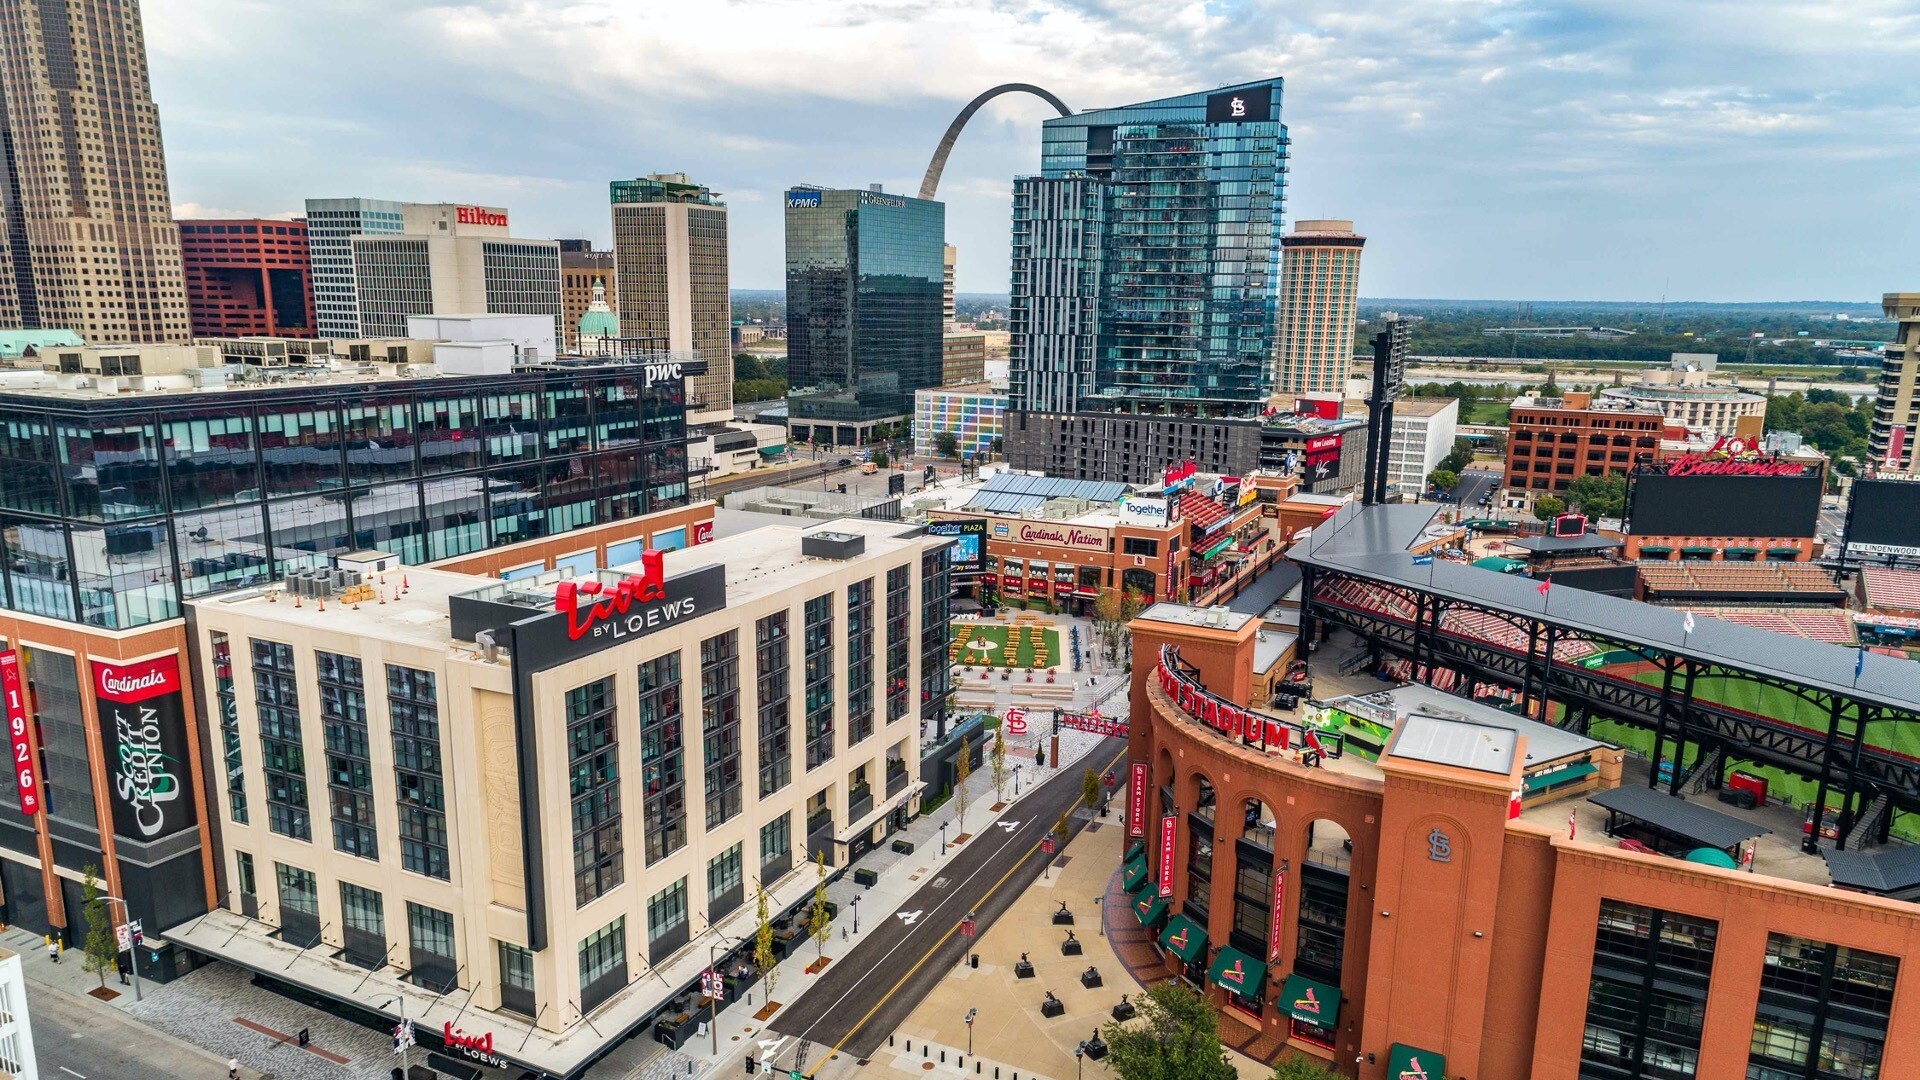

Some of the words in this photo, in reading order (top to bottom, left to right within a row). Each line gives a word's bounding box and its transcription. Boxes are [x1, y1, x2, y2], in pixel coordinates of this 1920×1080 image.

[787, 198, 818, 208] KPMG
[456, 207, 508, 227] Hilton
[644, 363, 682, 388] pwc
[1312, 440, 1321, 449] Now
[1321, 437, 1337, 447] Leasing
[1665, 453, 1805, 477] Budweiser
[1876, 471, 1920, 481] WORLD
[1126, 502, 1166, 515] Together
[929, 524, 962, 535] Together
[1020, 524, 1064, 542] Cardinals
[1064, 529, 1103, 546] Nation
[1864, 544, 1918, 555] LINDENWOOD
[555, 549, 667, 641] Live!
[593, 623, 611, 637] BY
[613, 597, 696, 639] LOEWS
[102, 668, 166, 694] Cardinals
[1180, 683, 1291, 751] STADIUM
[8, 690, 33, 788] 1926
[114, 709, 138, 802] SCOTT
[140, 706, 180, 804] UNION
[129, 723, 164, 836] CREDIT
[444, 1021, 494, 1055] Live!
[463, 1047, 508, 1070] LOEWS
